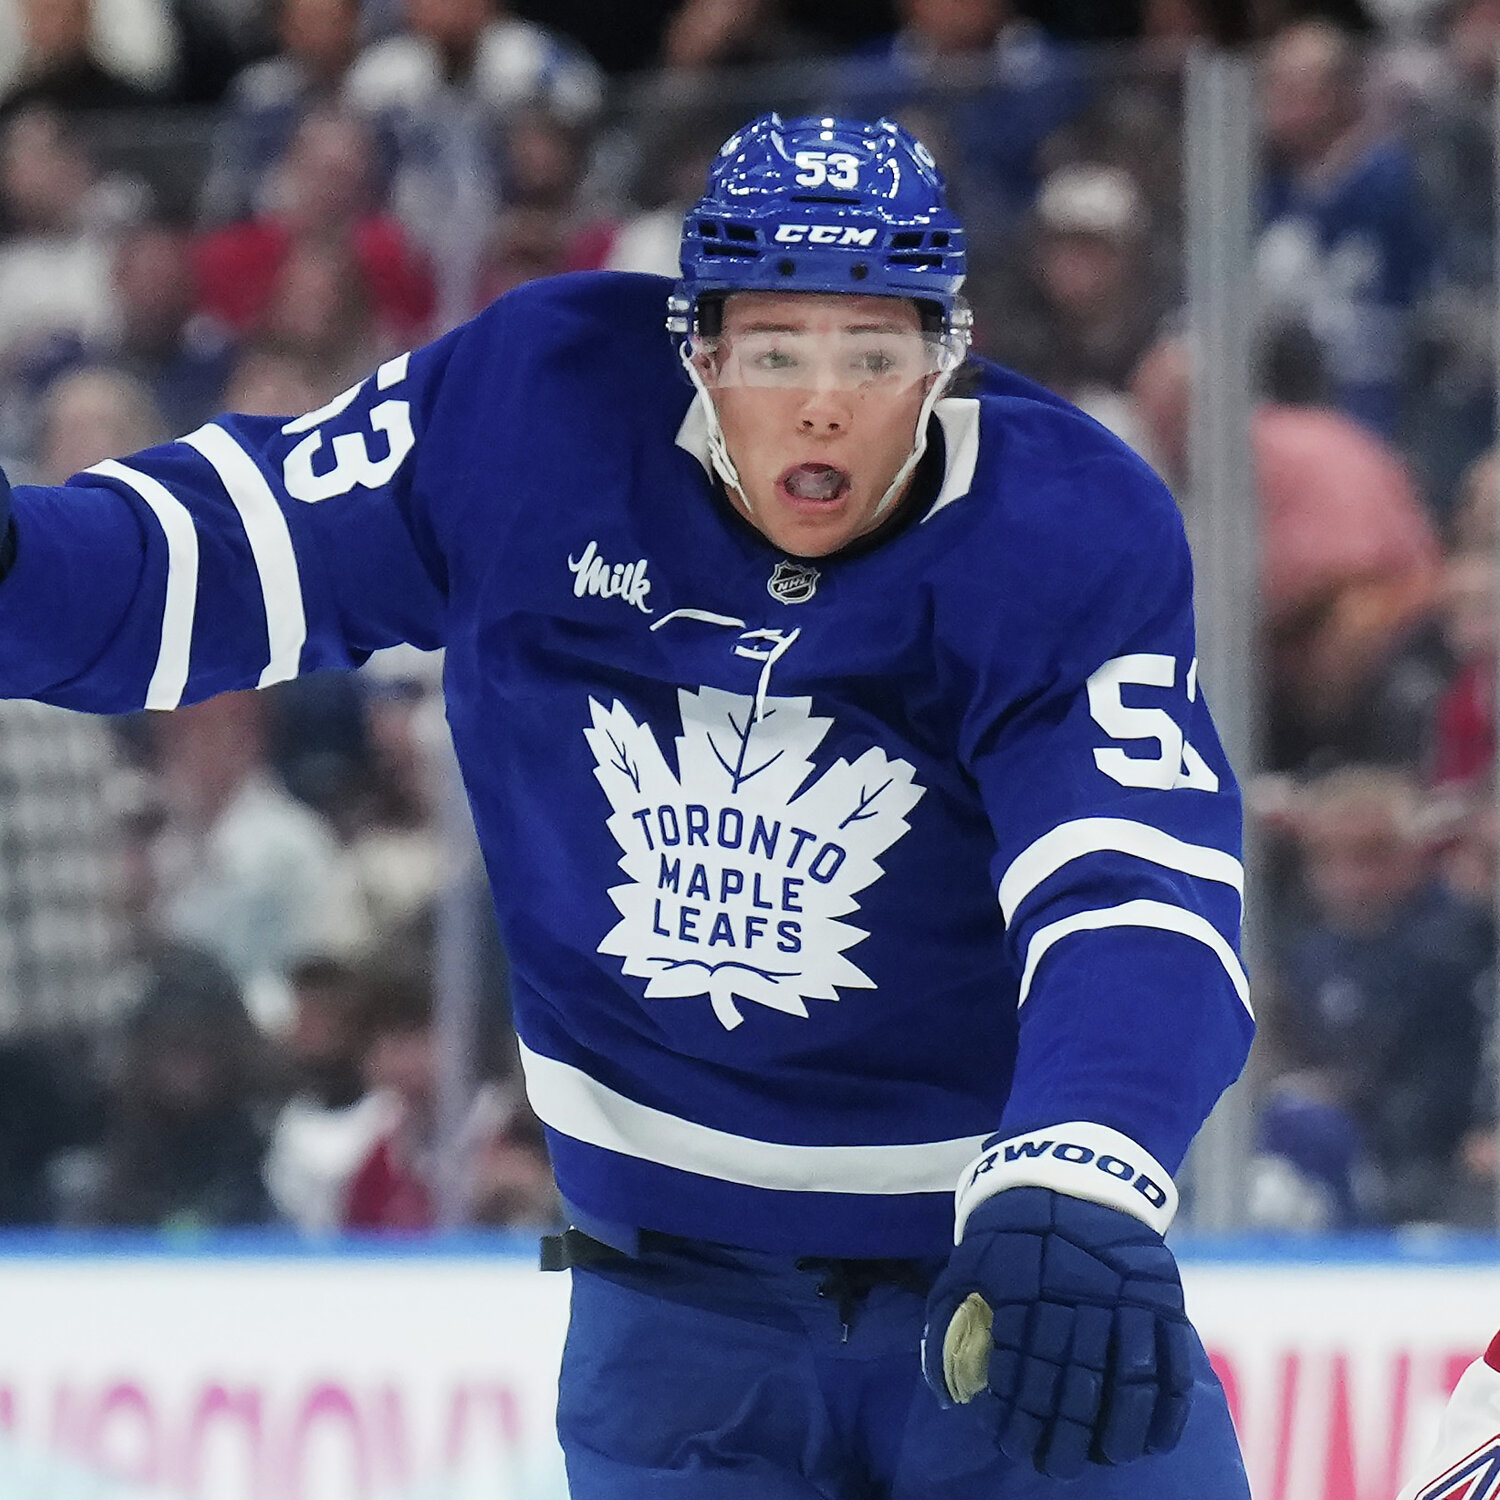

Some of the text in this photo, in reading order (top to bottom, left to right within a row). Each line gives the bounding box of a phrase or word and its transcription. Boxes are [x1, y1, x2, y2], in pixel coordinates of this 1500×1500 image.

[795, 152, 859, 189] 53
[774, 224, 877, 246] CCM
[568, 540, 654, 614] Milk
[632, 804, 847, 884] TORONTO
[657, 852, 804, 913] MAPLE
[653, 898, 802, 954] LEAFS
